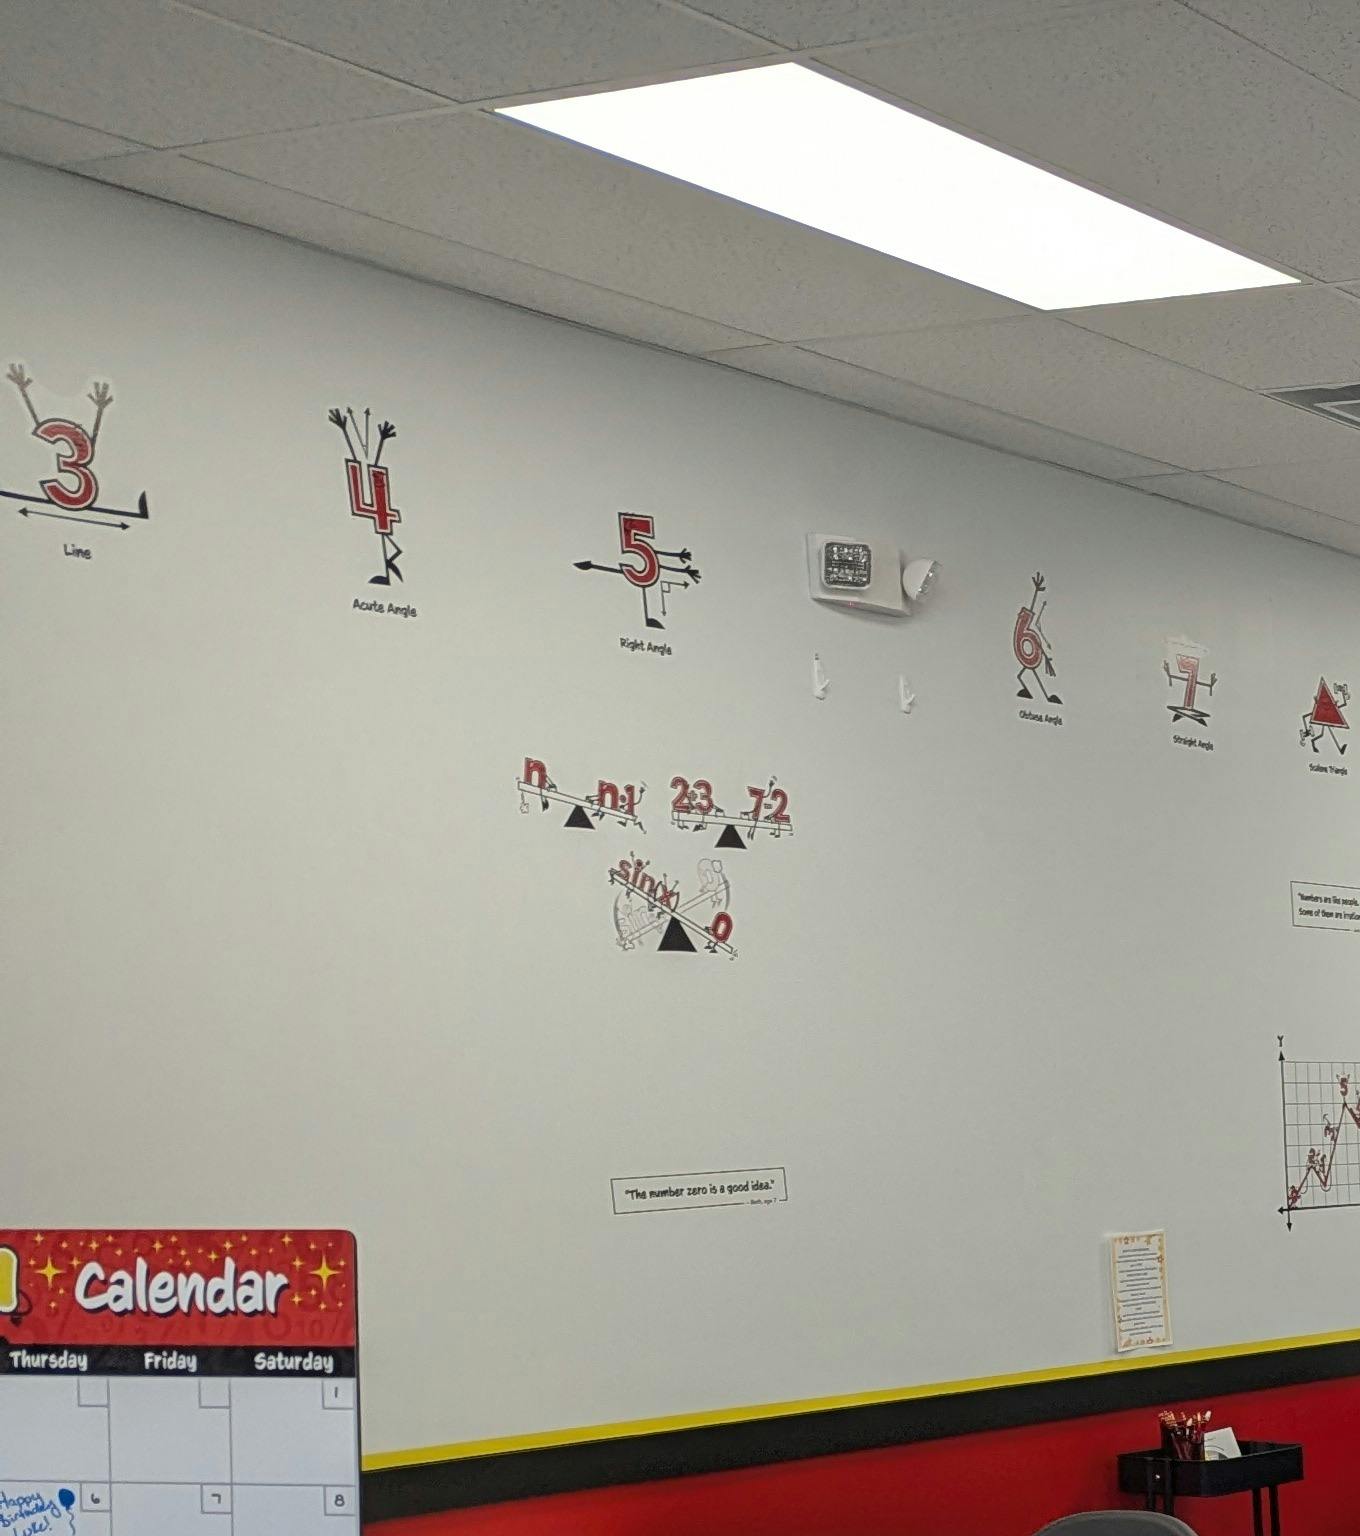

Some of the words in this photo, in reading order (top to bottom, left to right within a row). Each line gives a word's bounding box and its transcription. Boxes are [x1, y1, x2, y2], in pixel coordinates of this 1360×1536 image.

[32, 418, 99, 511] 3
[345, 458, 402, 535] 4
[63, 543, 92, 560] Line
[618, 512, 661, 588] 5
[353, 598, 385, 614] Acute
[387, 603, 418, 618] Angle
[620, 637, 646, 652] Right
[647, 642, 673, 656] Angle
[1013, 607, 1043, 669] 6
[649, 1186, 684, 1199] number
[687, 1185, 707, 1196] zero
[709, 1183, 718, 1194] is
[719, 1184, 725, 1194] a
[727, 1181, 749, 1195] good
[75, 1256, 288, 1314] Calendar
[9, 1349, 87, 1371] Thursday
[144, 1350, 198, 1372] Friday
[254, 1350, 334, 1373] Saturday
[91, 1493, 100, 1504] 6
[211, 1493, 222, 1504] 7
[334, 1494, 345, 1507] 8
